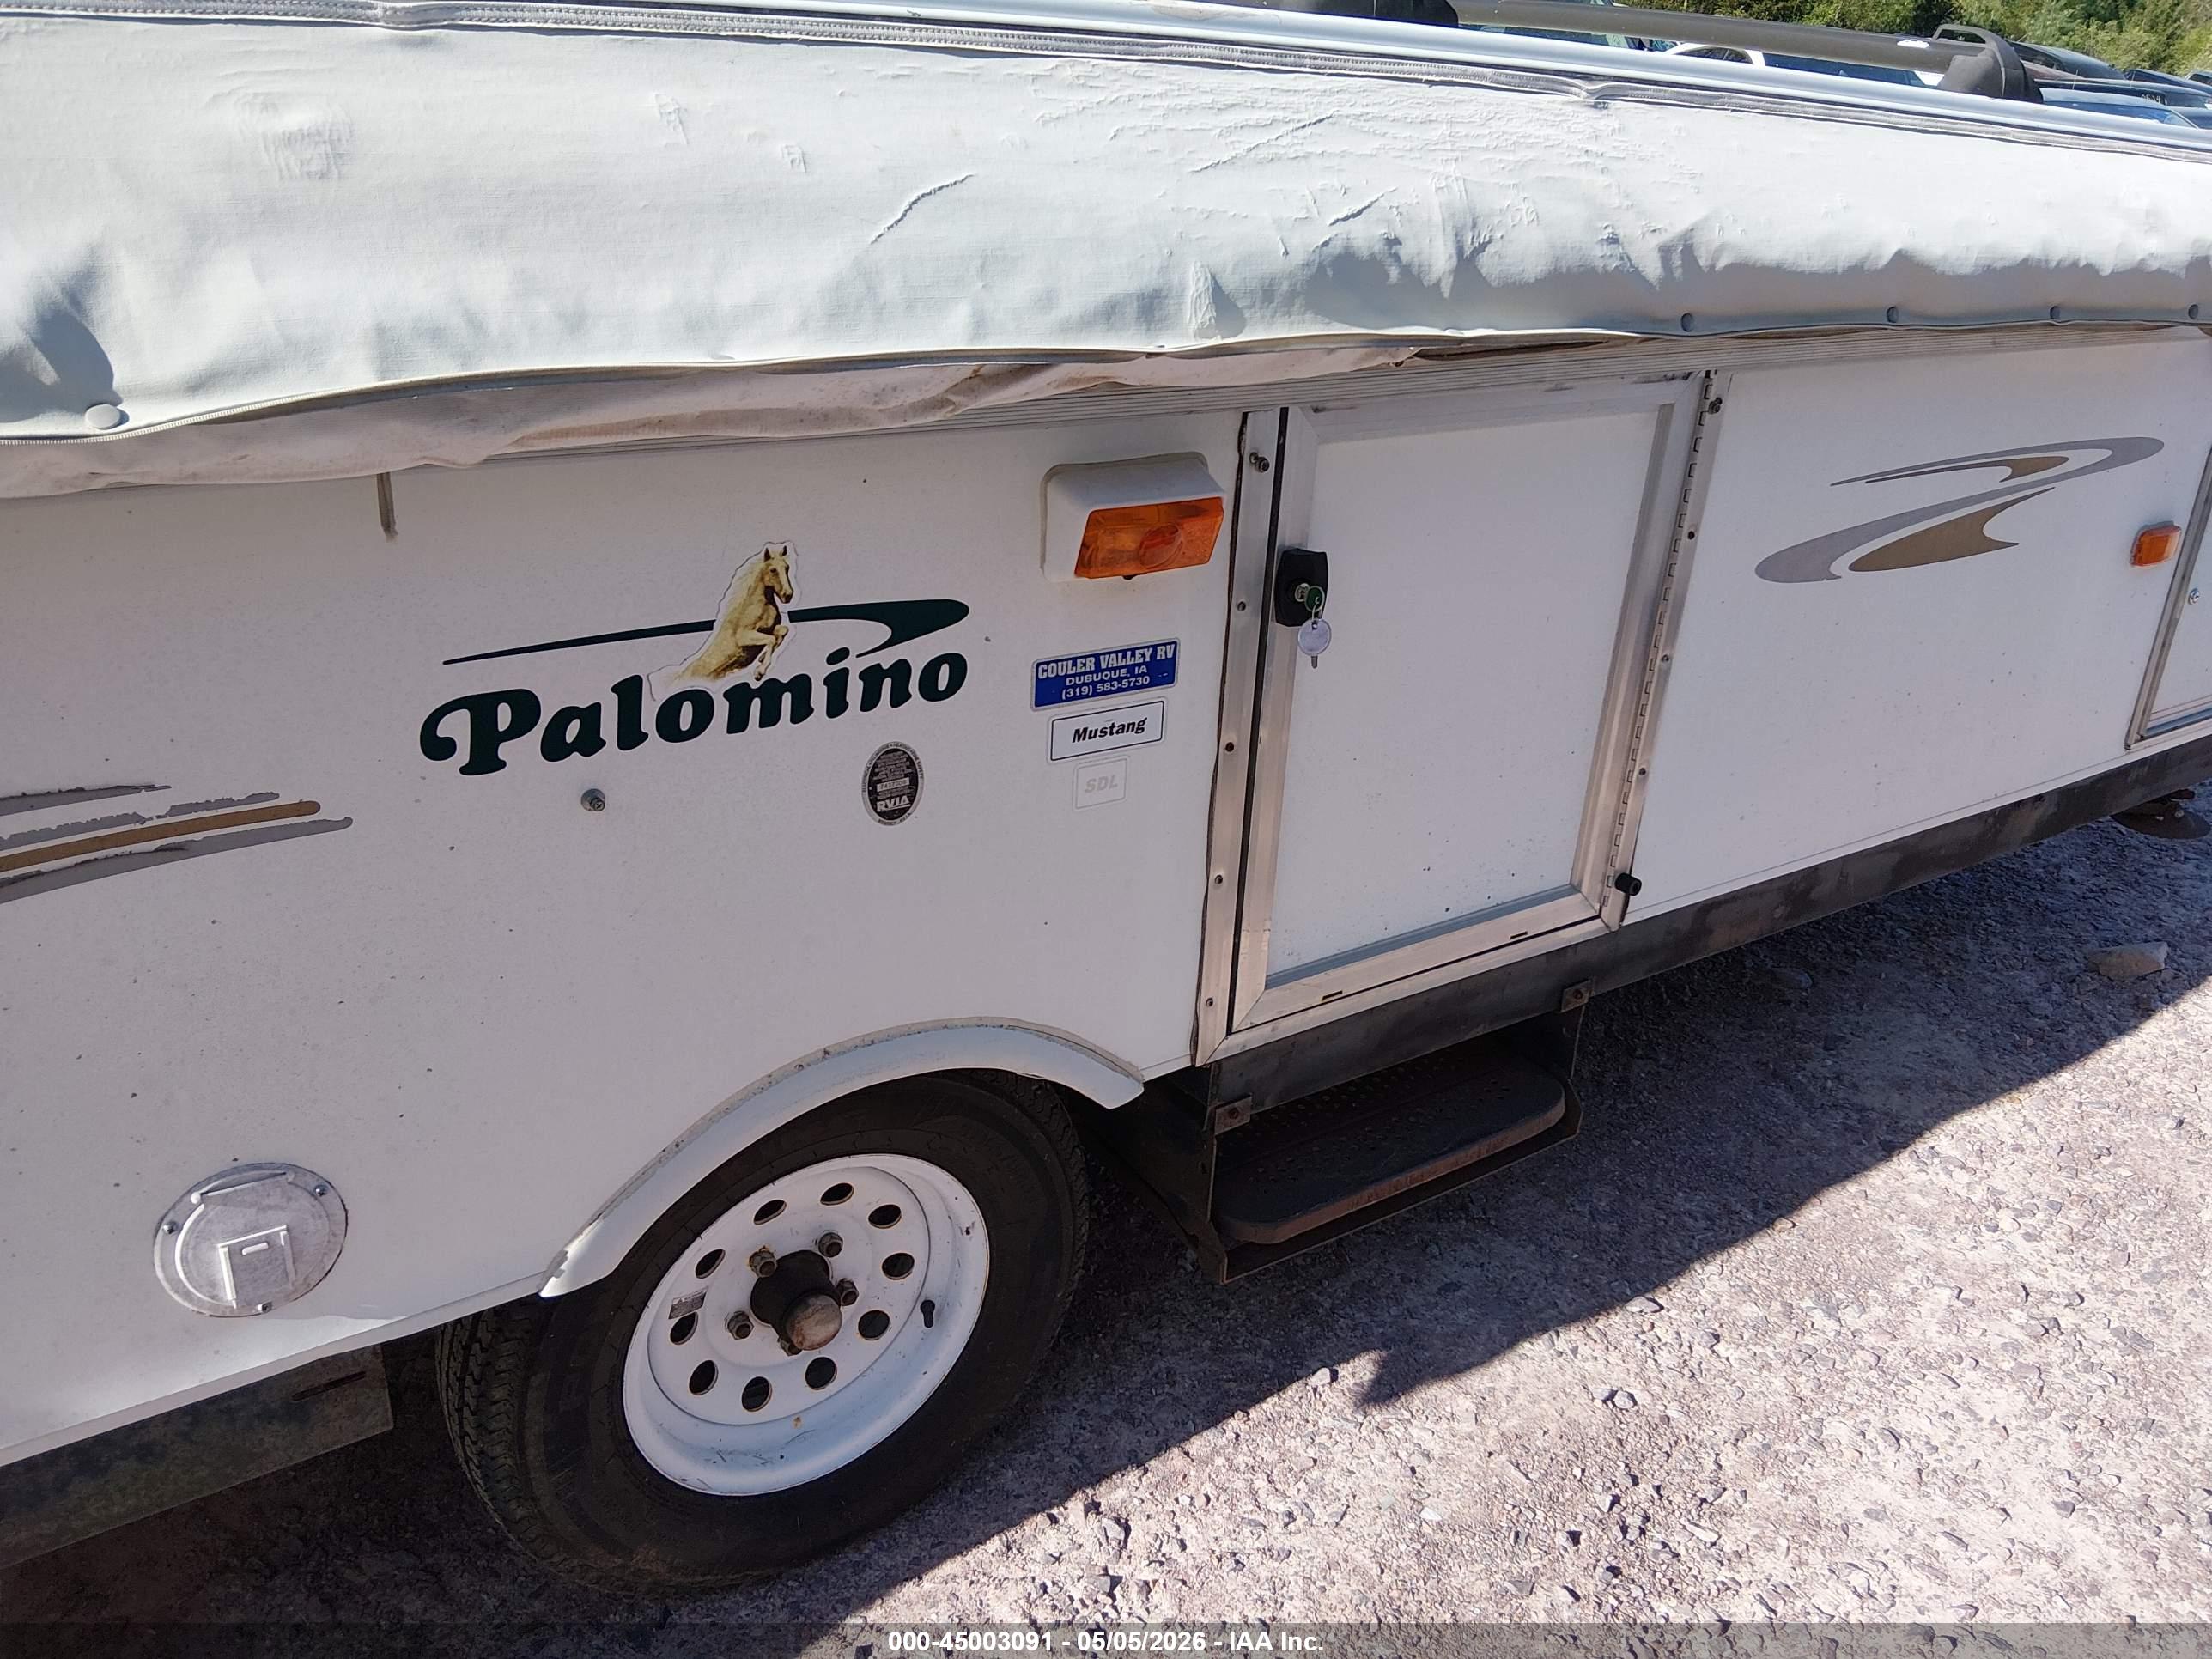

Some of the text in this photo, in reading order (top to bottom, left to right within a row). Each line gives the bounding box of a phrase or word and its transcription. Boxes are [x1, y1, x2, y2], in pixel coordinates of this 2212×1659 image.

[1038, 644, 1176, 679] COULER VALLEY RV
[1134, 665, 1148, 675] IA
[1061, 676, 1151, 700] (319) 583-5730
[420, 647, 968, 776] Palomino
[1072, 717, 1148, 744] Mustang
[1085, 775, 1119, 793] SDL
[877, 795, 909, 811] RVIA
